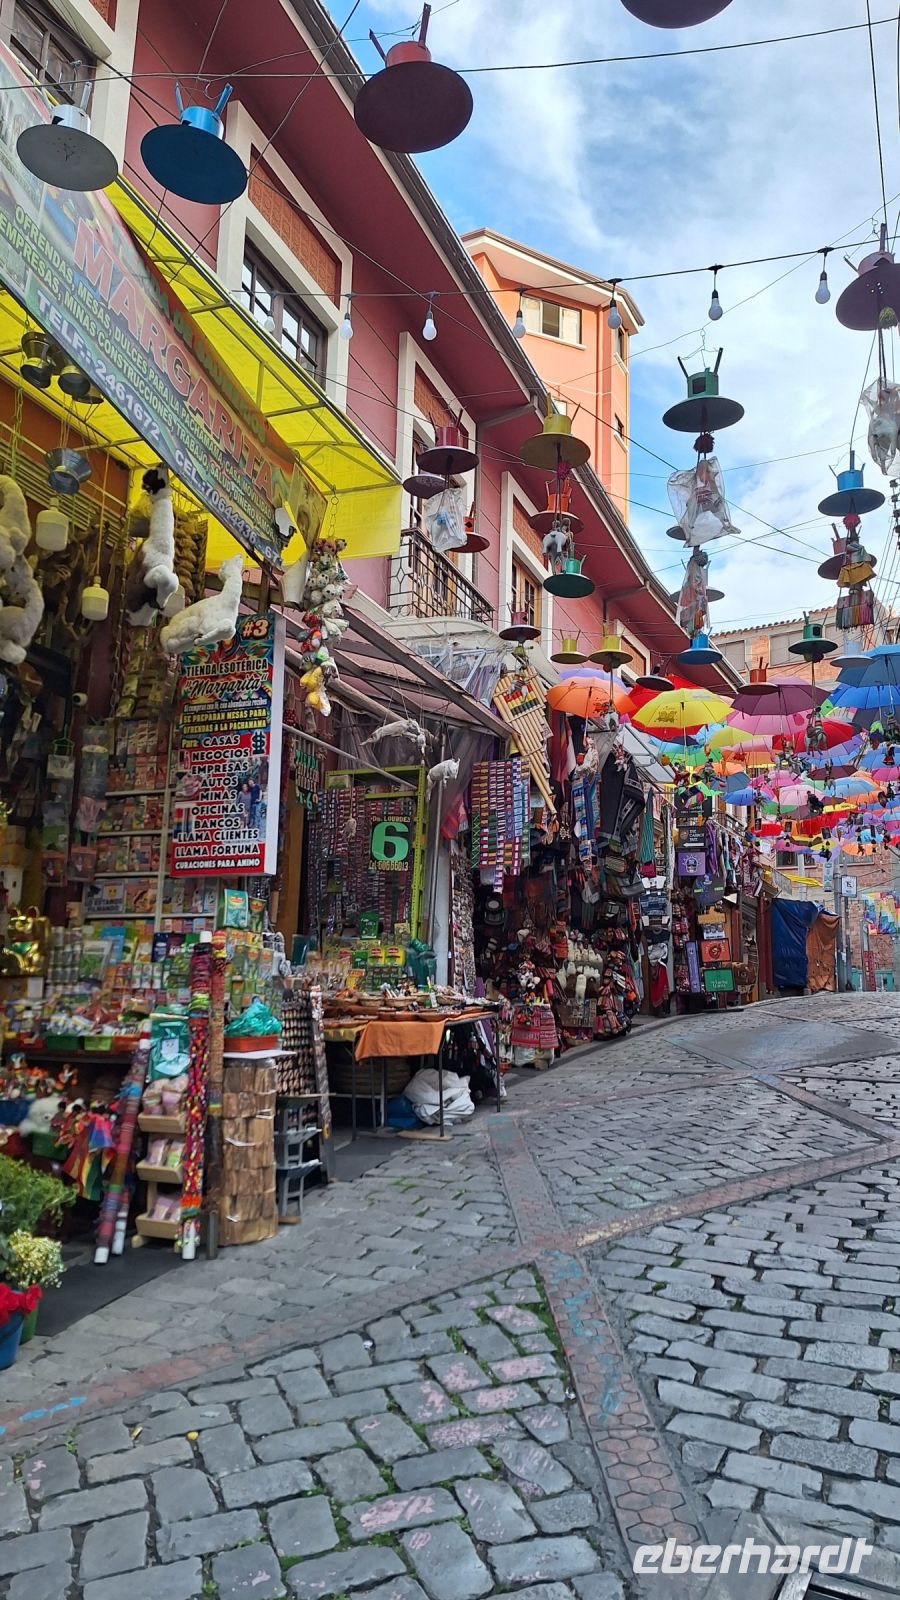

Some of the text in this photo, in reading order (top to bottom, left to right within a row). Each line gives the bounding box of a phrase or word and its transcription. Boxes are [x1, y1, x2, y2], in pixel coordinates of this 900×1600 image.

[0, 213, 61, 300] EMPRESAS,
[64, 290, 96, 337] MINAS
[98, 331, 174, 432] CONSTRUCCIONES,
[175, 424, 209, 471] TRABAJO,
[210, 463, 232, 495] SALUD,
[15, 204, 75, 291] OFRENDAS,
[78, 281, 112, 336] MESAS,
[114, 326, 148, 374] DULCES
[148, 371, 169, 398] PARA
[170, 395, 181, 413] LA
[181, 408, 223, 468] PACHAMAMA,
[242, 480, 272, 520] MOVILIDAD
[73, 217, 274, 505] MARGARITA
[95, 359, 160, 441] 2461672
[243, 619, 269, 638] #3
[186, 665, 217, 677] TIENDA
[184, 708, 267, 723] SE PREPARAN MESAS PARA
[184, 720, 266, 734] OFRENDAS A LA PACHAMAMA
[203, 736, 239, 747] CASAS
[192, 749, 249, 761] NEGOCIOS
[191, 762, 249, 775] EMPRESAS
[200, 777, 238, 788] AUTOS
[200, 791, 237, 801] MINAS
[191, 804, 244, 816] OFICINAS
[194, 818, 240, 829] BANCOS
[177, 829, 259, 842] LLAMA CLIENTES
[371, 821, 409, 861] 6
[175, 843, 259, 857] LLAMA FORTUNA
[175, 858, 260, 870] CURACIONES PARA ANIMO
